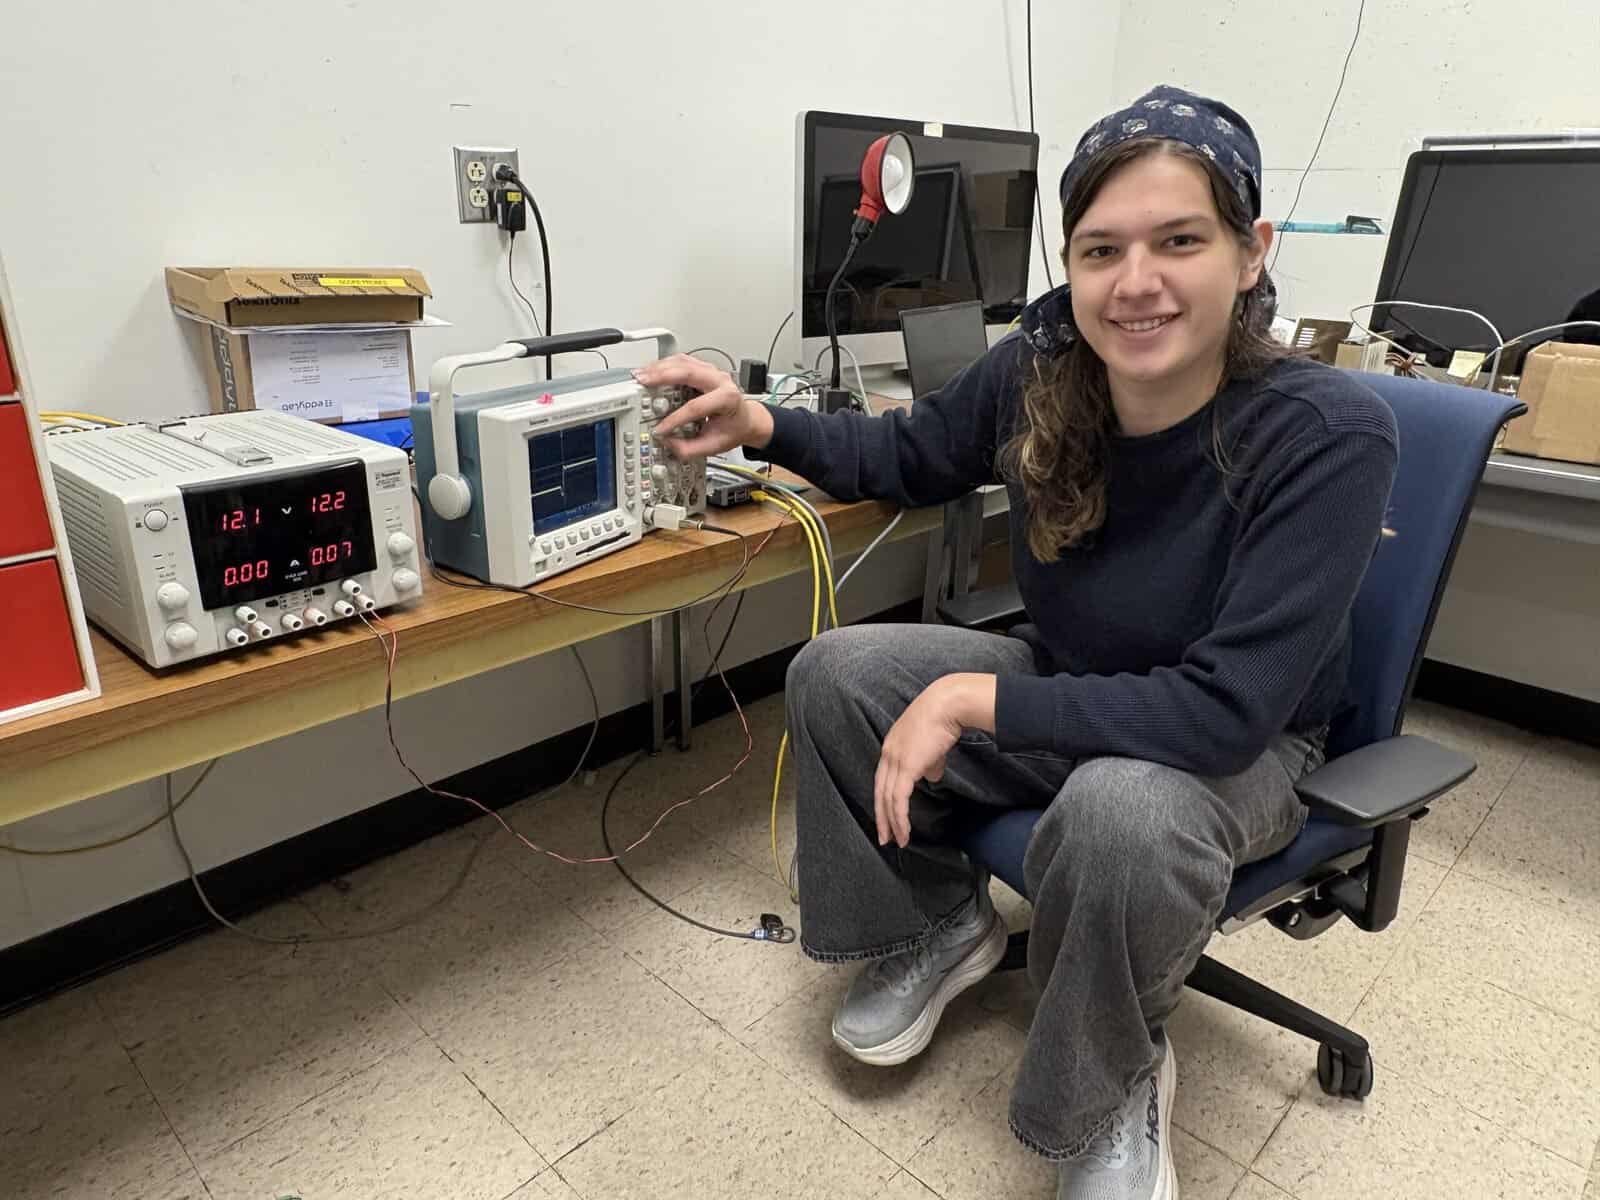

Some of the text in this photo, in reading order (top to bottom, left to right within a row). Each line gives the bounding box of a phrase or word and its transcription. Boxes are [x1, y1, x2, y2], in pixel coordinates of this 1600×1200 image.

[311, 490, 345, 513] 12.2
[222, 508, 260, 531] 12.1
[311, 541, 352, 566] 0.07
[224, 560, 269, 586] 0.00
